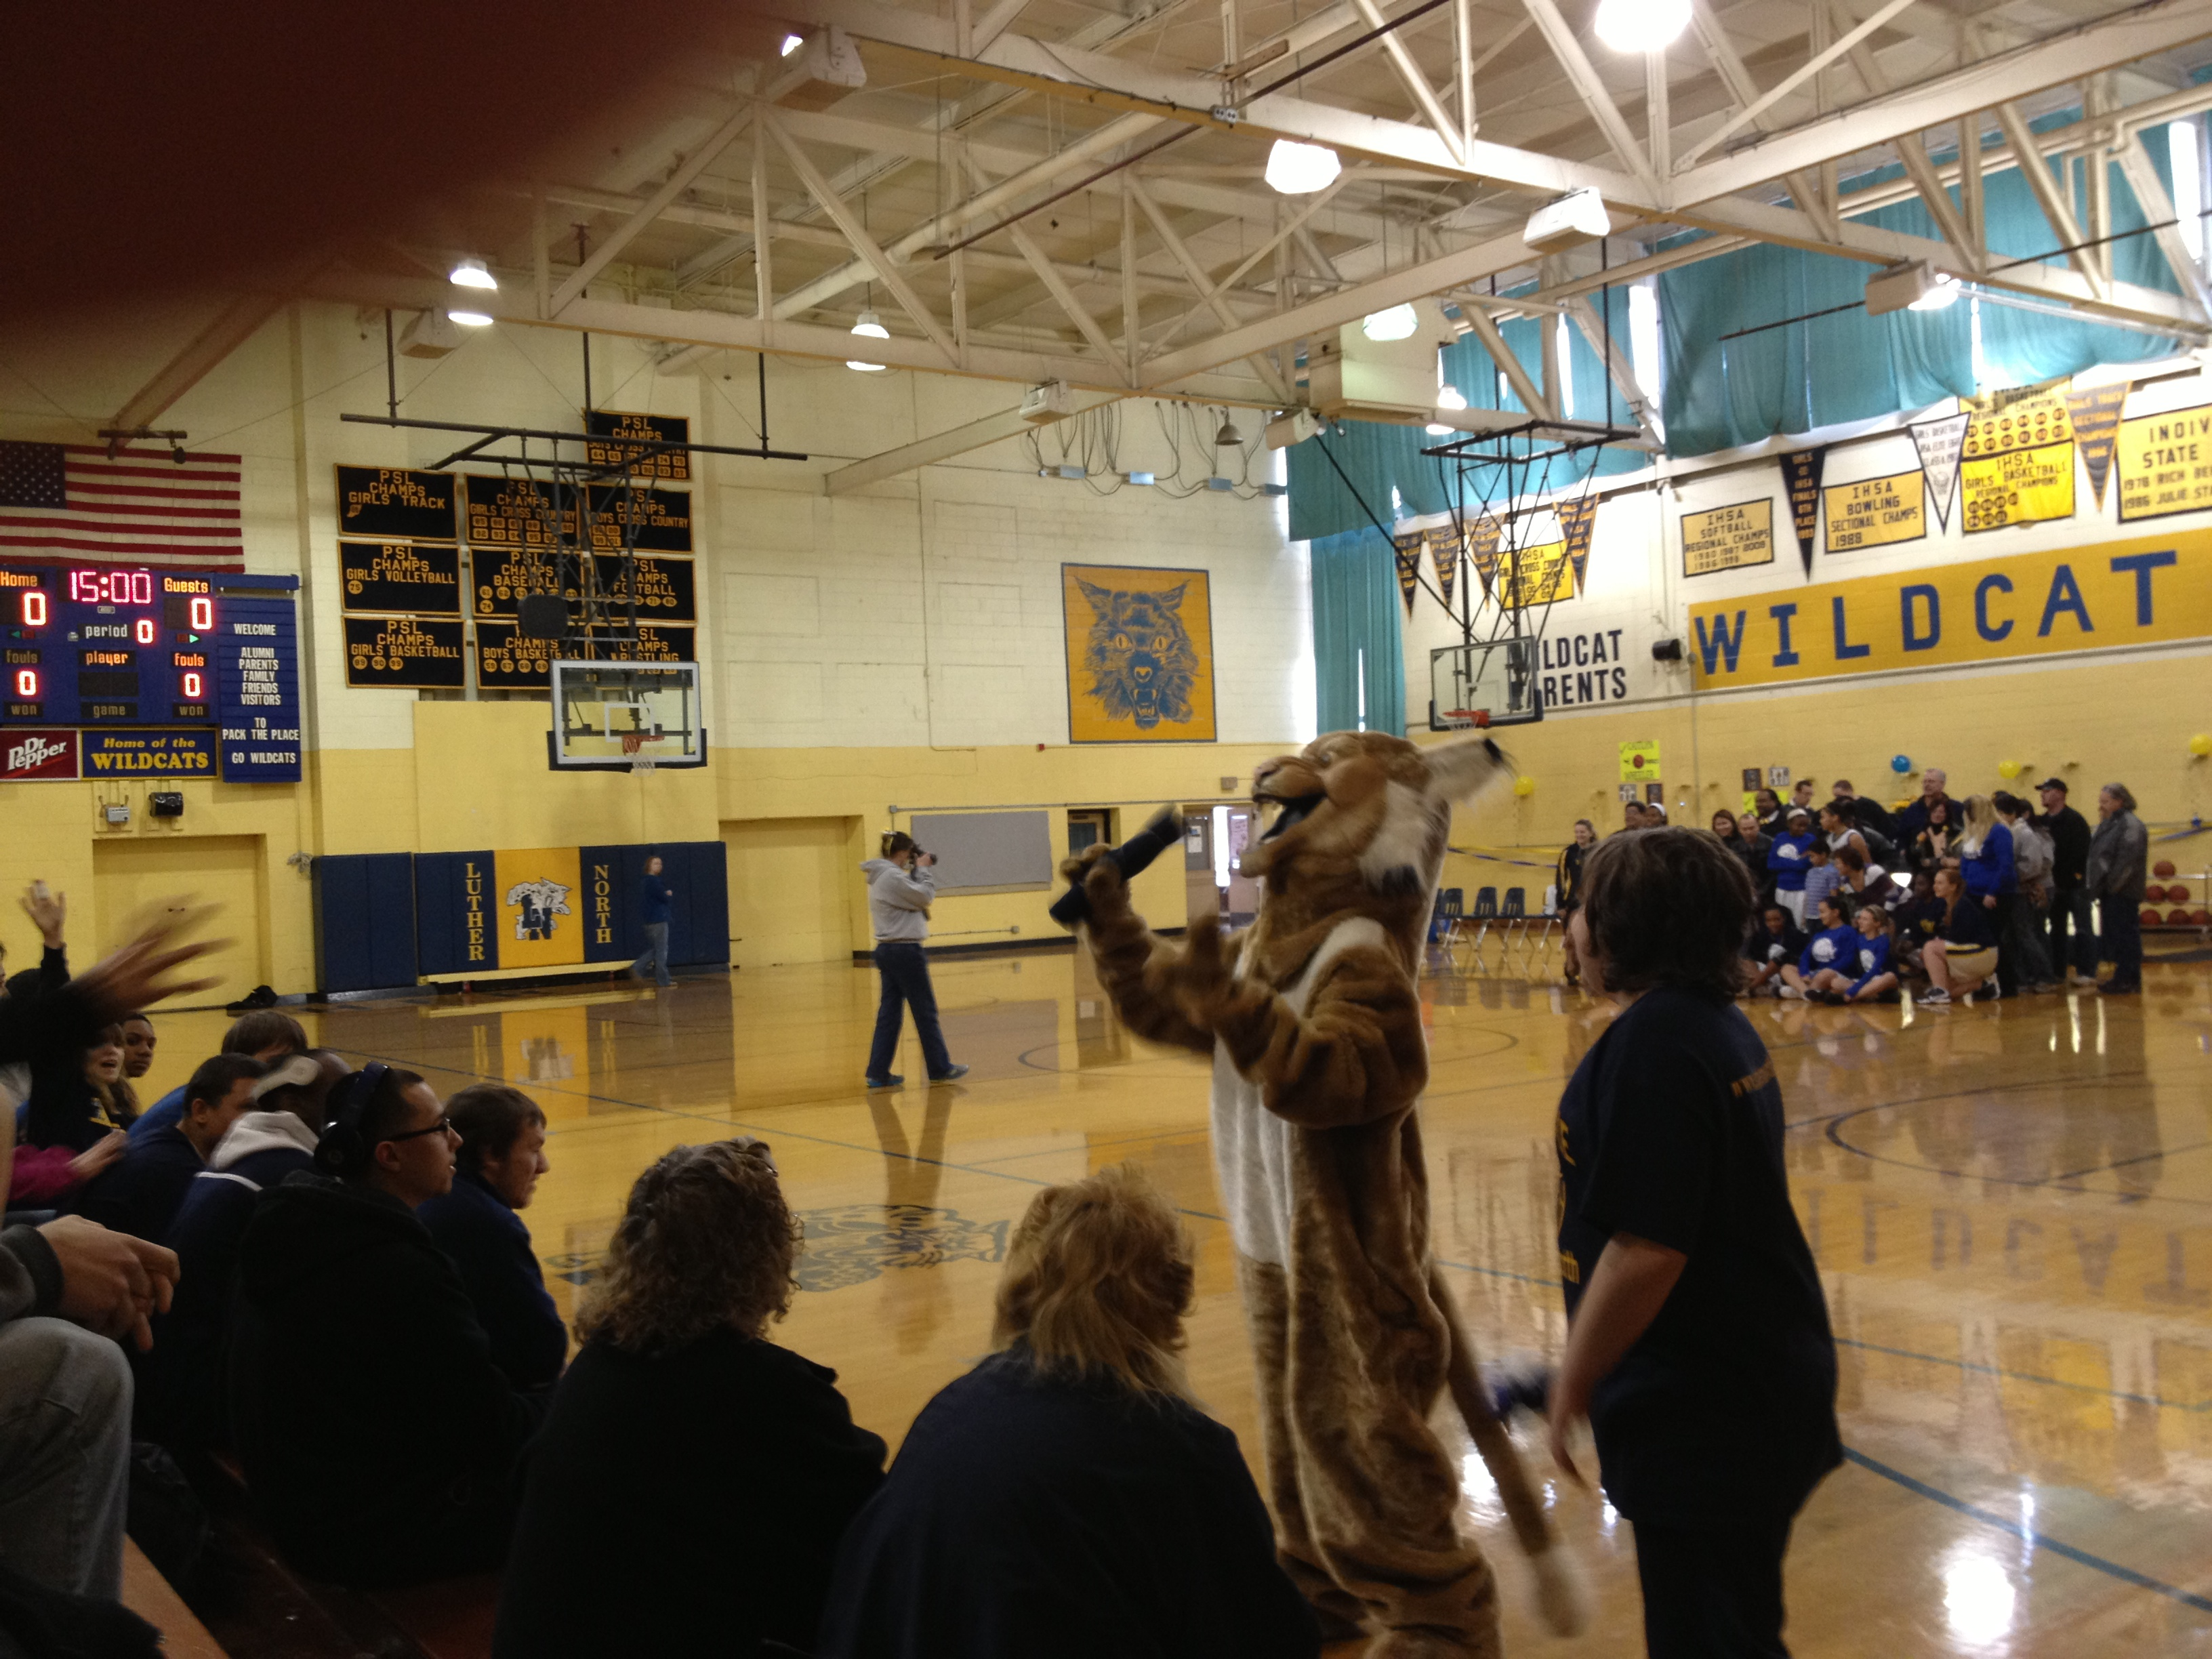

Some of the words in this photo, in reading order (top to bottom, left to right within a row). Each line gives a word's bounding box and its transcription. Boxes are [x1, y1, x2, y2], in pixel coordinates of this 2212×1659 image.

[621, 416, 653, 430] PSL
[612, 428, 663, 441] CHAMPS
[1996, 452, 2034, 471] IHSA
[2143, 443, 2198, 469] STATE
[380, 470, 415, 485] PSL
[1965, 476, 1994, 489] GIRLS
[2003, 462, 2067, 482] BASKETBALL
[369, 483, 426, 497] CHAMPS
[1853, 481, 1893, 499] IHSA
[348, 492, 390, 506] GIRLS
[402, 495, 446, 510] TRACK
[1847, 495, 1900, 516] BOWLING
[650, 516, 689, 529] COUNTRY
[1707, 508, 1744, 526] IHSA
[1830, 514, 1875, 533] SECTIONAL
[1882, 506, 1918, 525] CHAMPS
[1700, 520, 1753, 539] SOFTBALL
[1685, 537, 1727, 553] REGIONAL
[1733, 529, 1770, 544] CHAMPS
[1835, 532, 1862, 547] 1988
[382, 546, 418, 560] PSL
[372, 558, 430, 572] CHAMPS
[0, 571, 38, 588] Home
[346, 568, 380, 581] GIRLS
[385, 570, 456, 584] VOLLEYBALL
[70, 571, 152, 605] 15:00
[164, 577, 208, 594] Guests
[23, 592, 47, 626] 0
[190, 598, 213, 630] 0
[1694, 550, 2177, 676] WILDCAT
[85, 623, 128, 639] period
[136, 619, 154, 644] 0
[234, 623, 276, 636] WELCOME
[386, 620, 423, 635] PSL
[377, 633, 435, 647] CHAMPS
[5, 649, 39, 664] fouls
[241, 647, 275, 659] ALUMNI
[351, 644, 384, 656] GIRLS
[389, 645, 460, 659] BASKETBALL
[483, 648, 510, 659] BOYS
[1542, 629, 1622, 670] LDCAT
[85, 650, 129, 666] player
[174, 653, 205, 667] fouls
[239, 659, 279, 670] PARENTS
[18, 670, 37, 696] 0
[243, 670, 275, 682] FAMILY
[184, 672, 201, 697] 0
[242, 682, 279, 694] FRIENDS
[1543, 666, 1626, 707] RENTS
[241, 694, 282, 706] VISITORS
[11, 705, 38, 716] won
[93, 705, 126, 718] game
[179, 706, 204, 716] won
[253, 717, 267, 729] TO
[103, 737, 146, 749] Home
[151, 737, 167, 749] of
[171, 737, 197, 749] the
[222, 729, 247, 741] PACK
[251, 729, 268, 741] THE
[271, 729, 300, 741] PLACE
[24, 737, 46, 755] Dr
[7, 741, 67, 771] Pepper
[90, 752, 209, 771] WILDCATS
[231, 752, 245, 764] GO
[249, 752, 297, 764] WILDCATS
[465, 862, 486, 962] LUTHER
[593, 864, 613, 944] NORTH
